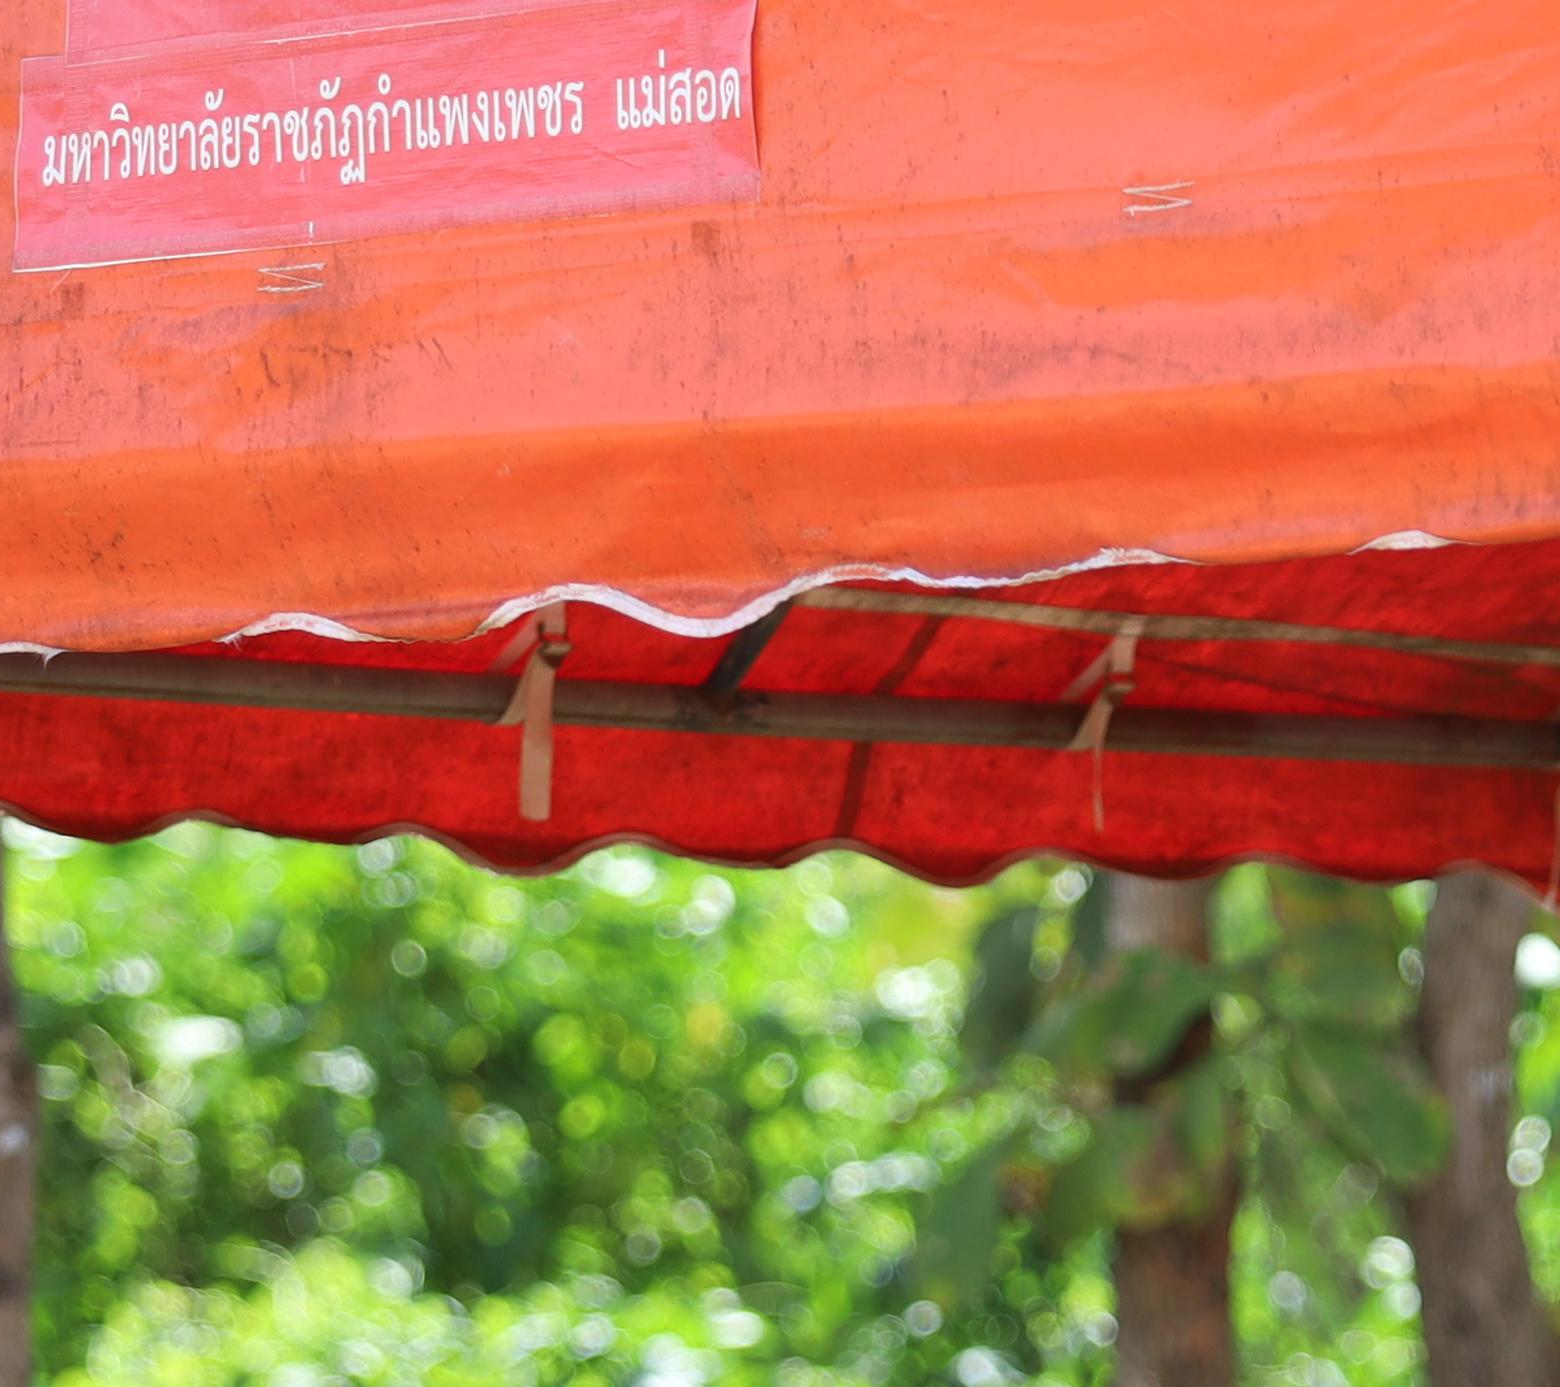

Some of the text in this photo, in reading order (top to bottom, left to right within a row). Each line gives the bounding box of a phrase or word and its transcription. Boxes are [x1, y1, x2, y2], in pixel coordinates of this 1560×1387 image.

[41, 50, 742, 186] มหาวิทยาลัยราชภัฏกำแพงเพชร แม่สอด
